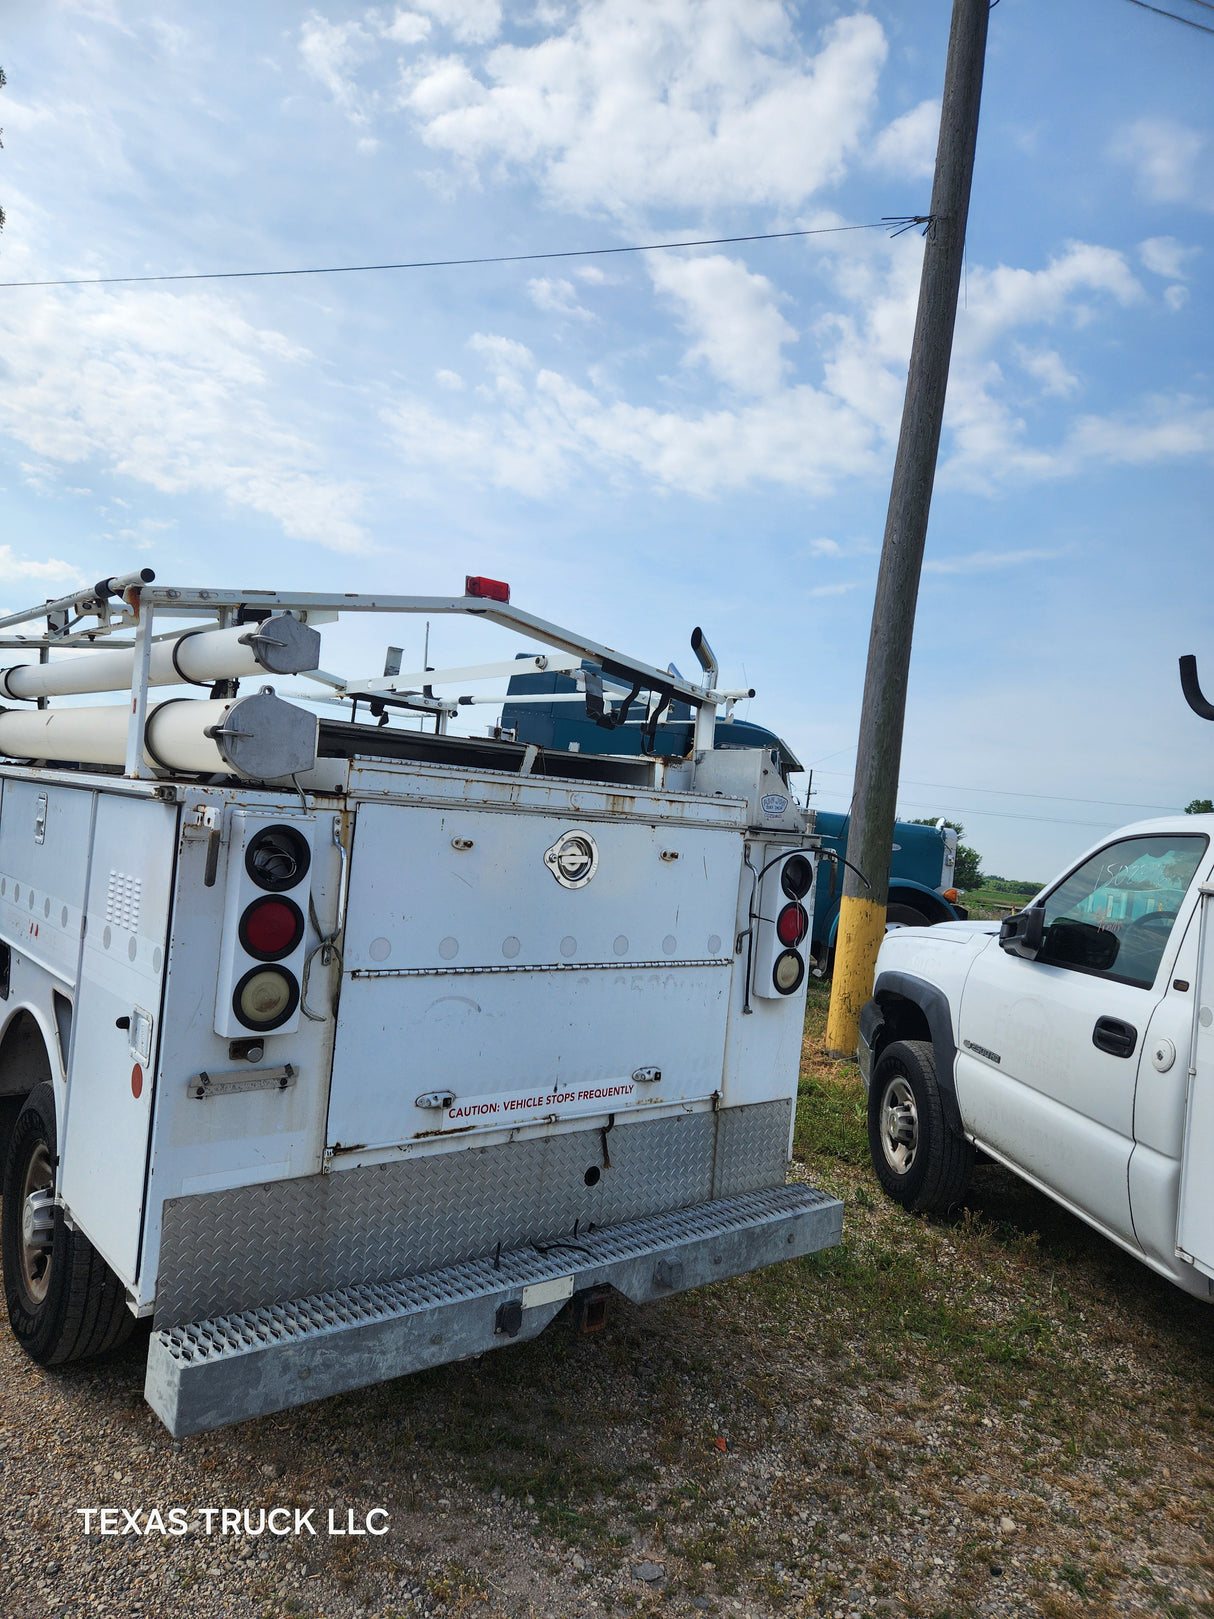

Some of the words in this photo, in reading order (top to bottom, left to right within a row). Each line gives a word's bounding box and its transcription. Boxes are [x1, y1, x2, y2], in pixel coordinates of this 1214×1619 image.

[448, 1103, 500, 1119] CAUTION:
[503, 1096, 543, 1112] VEHICLE
[546, 1092, 575, 1105] STOPS
[577, 1085, 635, 1101] FREQUENTLY
